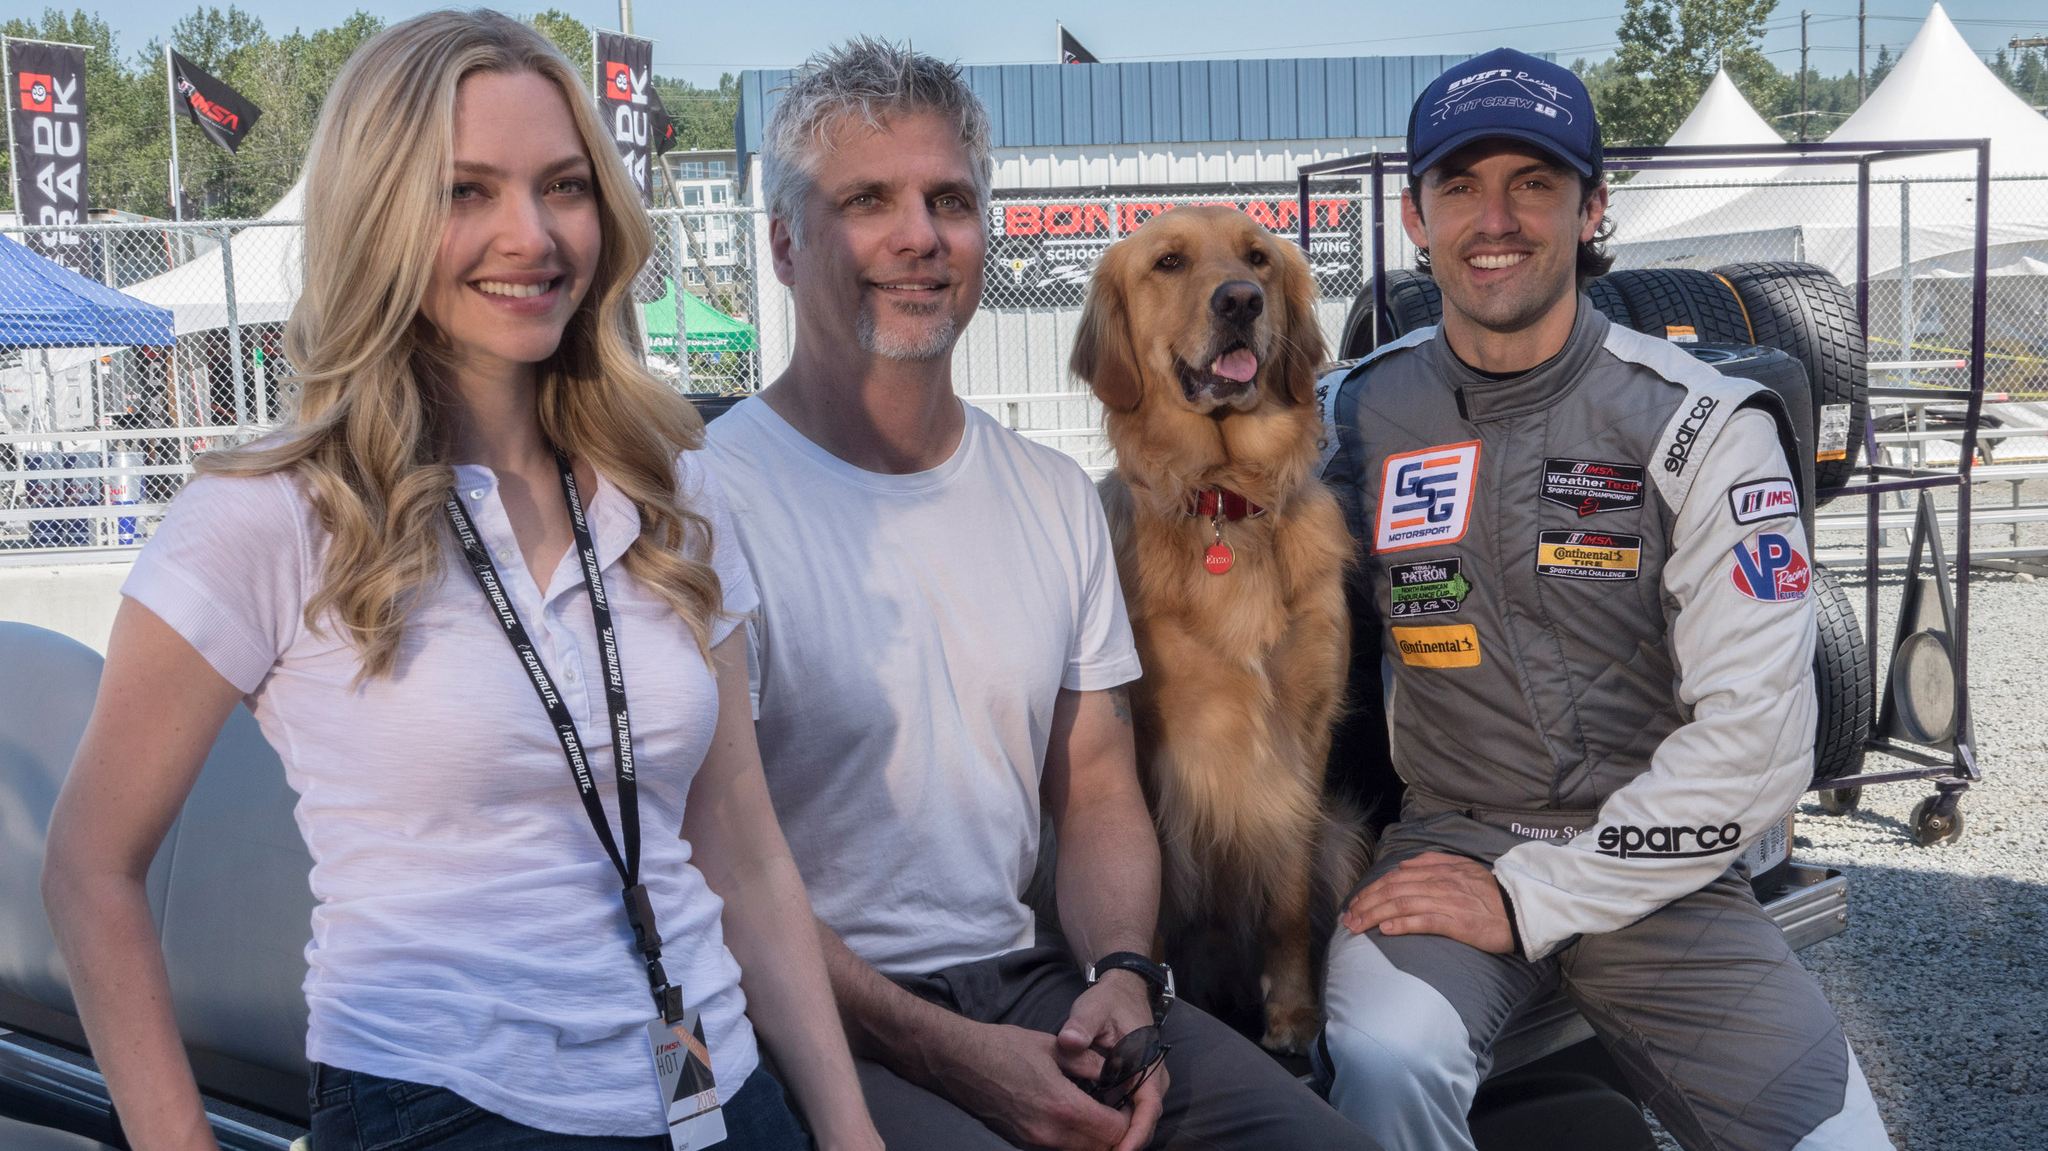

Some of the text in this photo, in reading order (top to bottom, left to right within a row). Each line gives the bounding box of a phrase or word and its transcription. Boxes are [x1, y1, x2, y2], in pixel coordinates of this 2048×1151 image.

[1448, 69, 1558, 100] SWIFT Racing
[1454, 99, 1482, 115] PIT
[1482, 96, 1534, 110] CREW
[33, 116, 64, 267] OAD
[992, 206, 1005, 236] BOB
[1005, 199, 1350, 236] BONDANT
[1664, 395, 1714, 474] sparco
[1586, 465, 1615, 477] IMSA
[1766, 490, 1793, 508] IMS
[1388, 525, 1452, 543] MOTORSPORT
[1582, 535, 1613, 546] IMSA
[1206, 554, 1230, 565] Enzo
[1554, 546, 1613, 561] Continental
[1572, 559, 1603, 567] TIRE
[1731, 532, 1791, 601] VP
[1777, 565, 1809, 591] Racing
[1780, 591, 1805, 600] FUELS
[1399, 639, 1461, 655] Continental
[1511, 822, 1558, 839] Denny
[1597, 822, 1742, 860] sparco
[663, 1040, 681, 1053] IMSA
[656, 1052, 679, 1078] HOT
[695, 1089, 718, 1111] 2018
